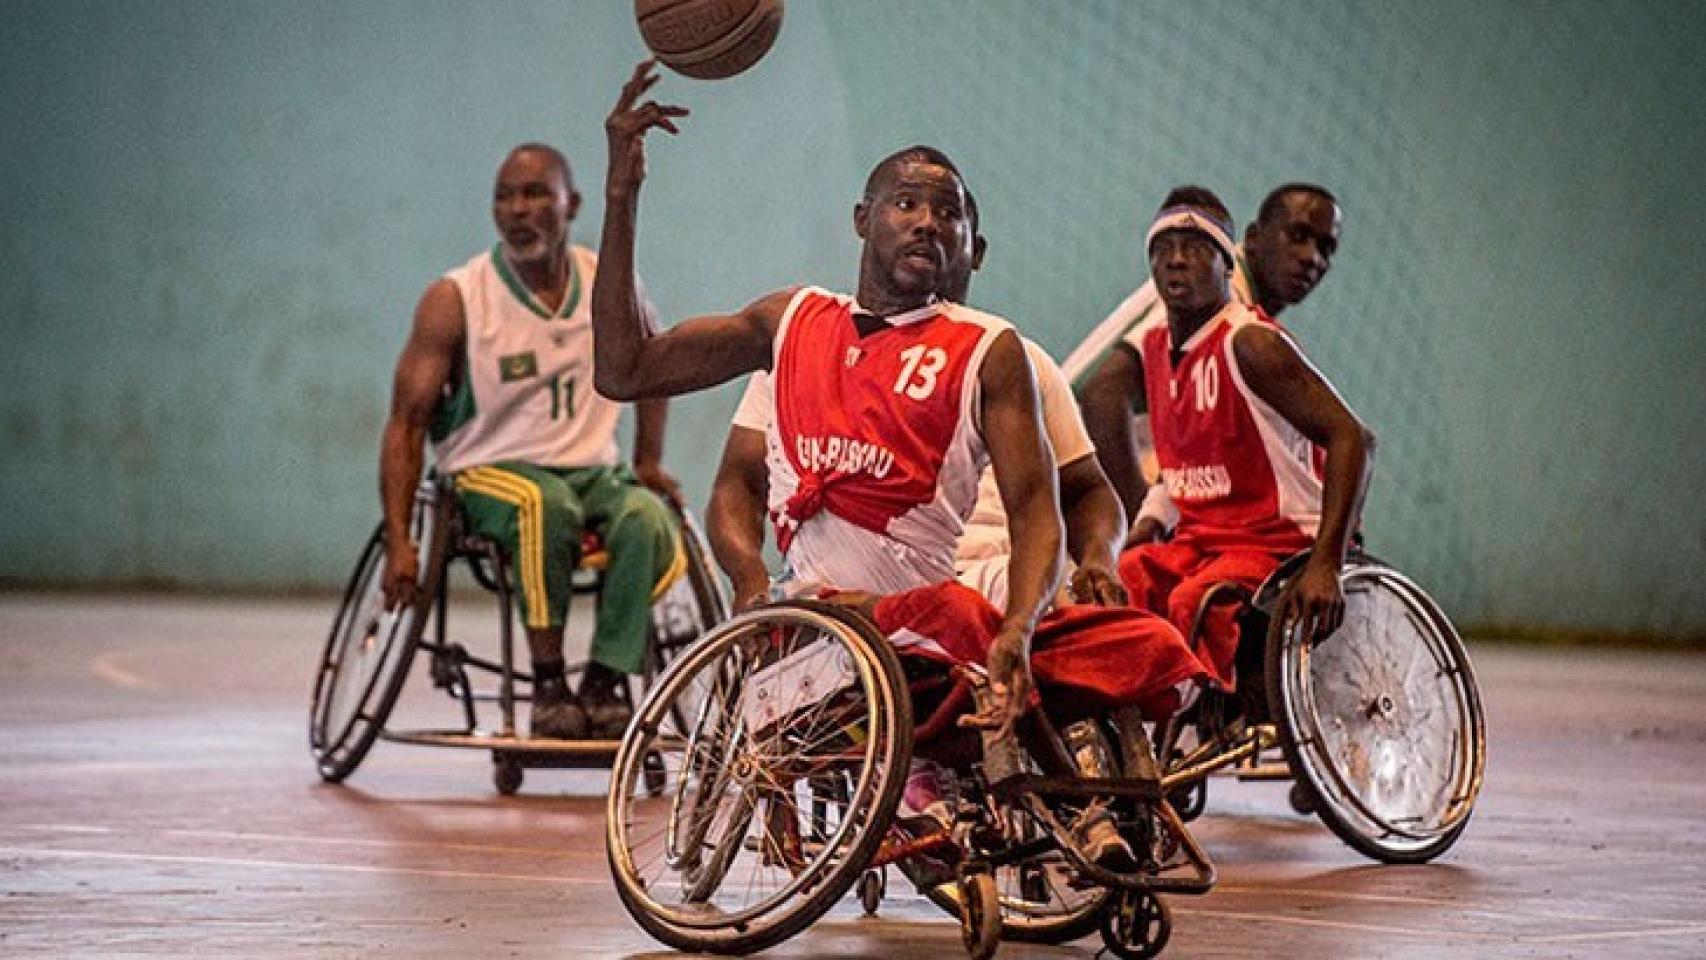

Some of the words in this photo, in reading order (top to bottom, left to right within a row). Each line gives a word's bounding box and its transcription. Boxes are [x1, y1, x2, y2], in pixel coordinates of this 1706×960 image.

[544, 374, 575, 420] 11
[893, 344, 948, 400] 13
[1190, 355, 1219, 411] 10
